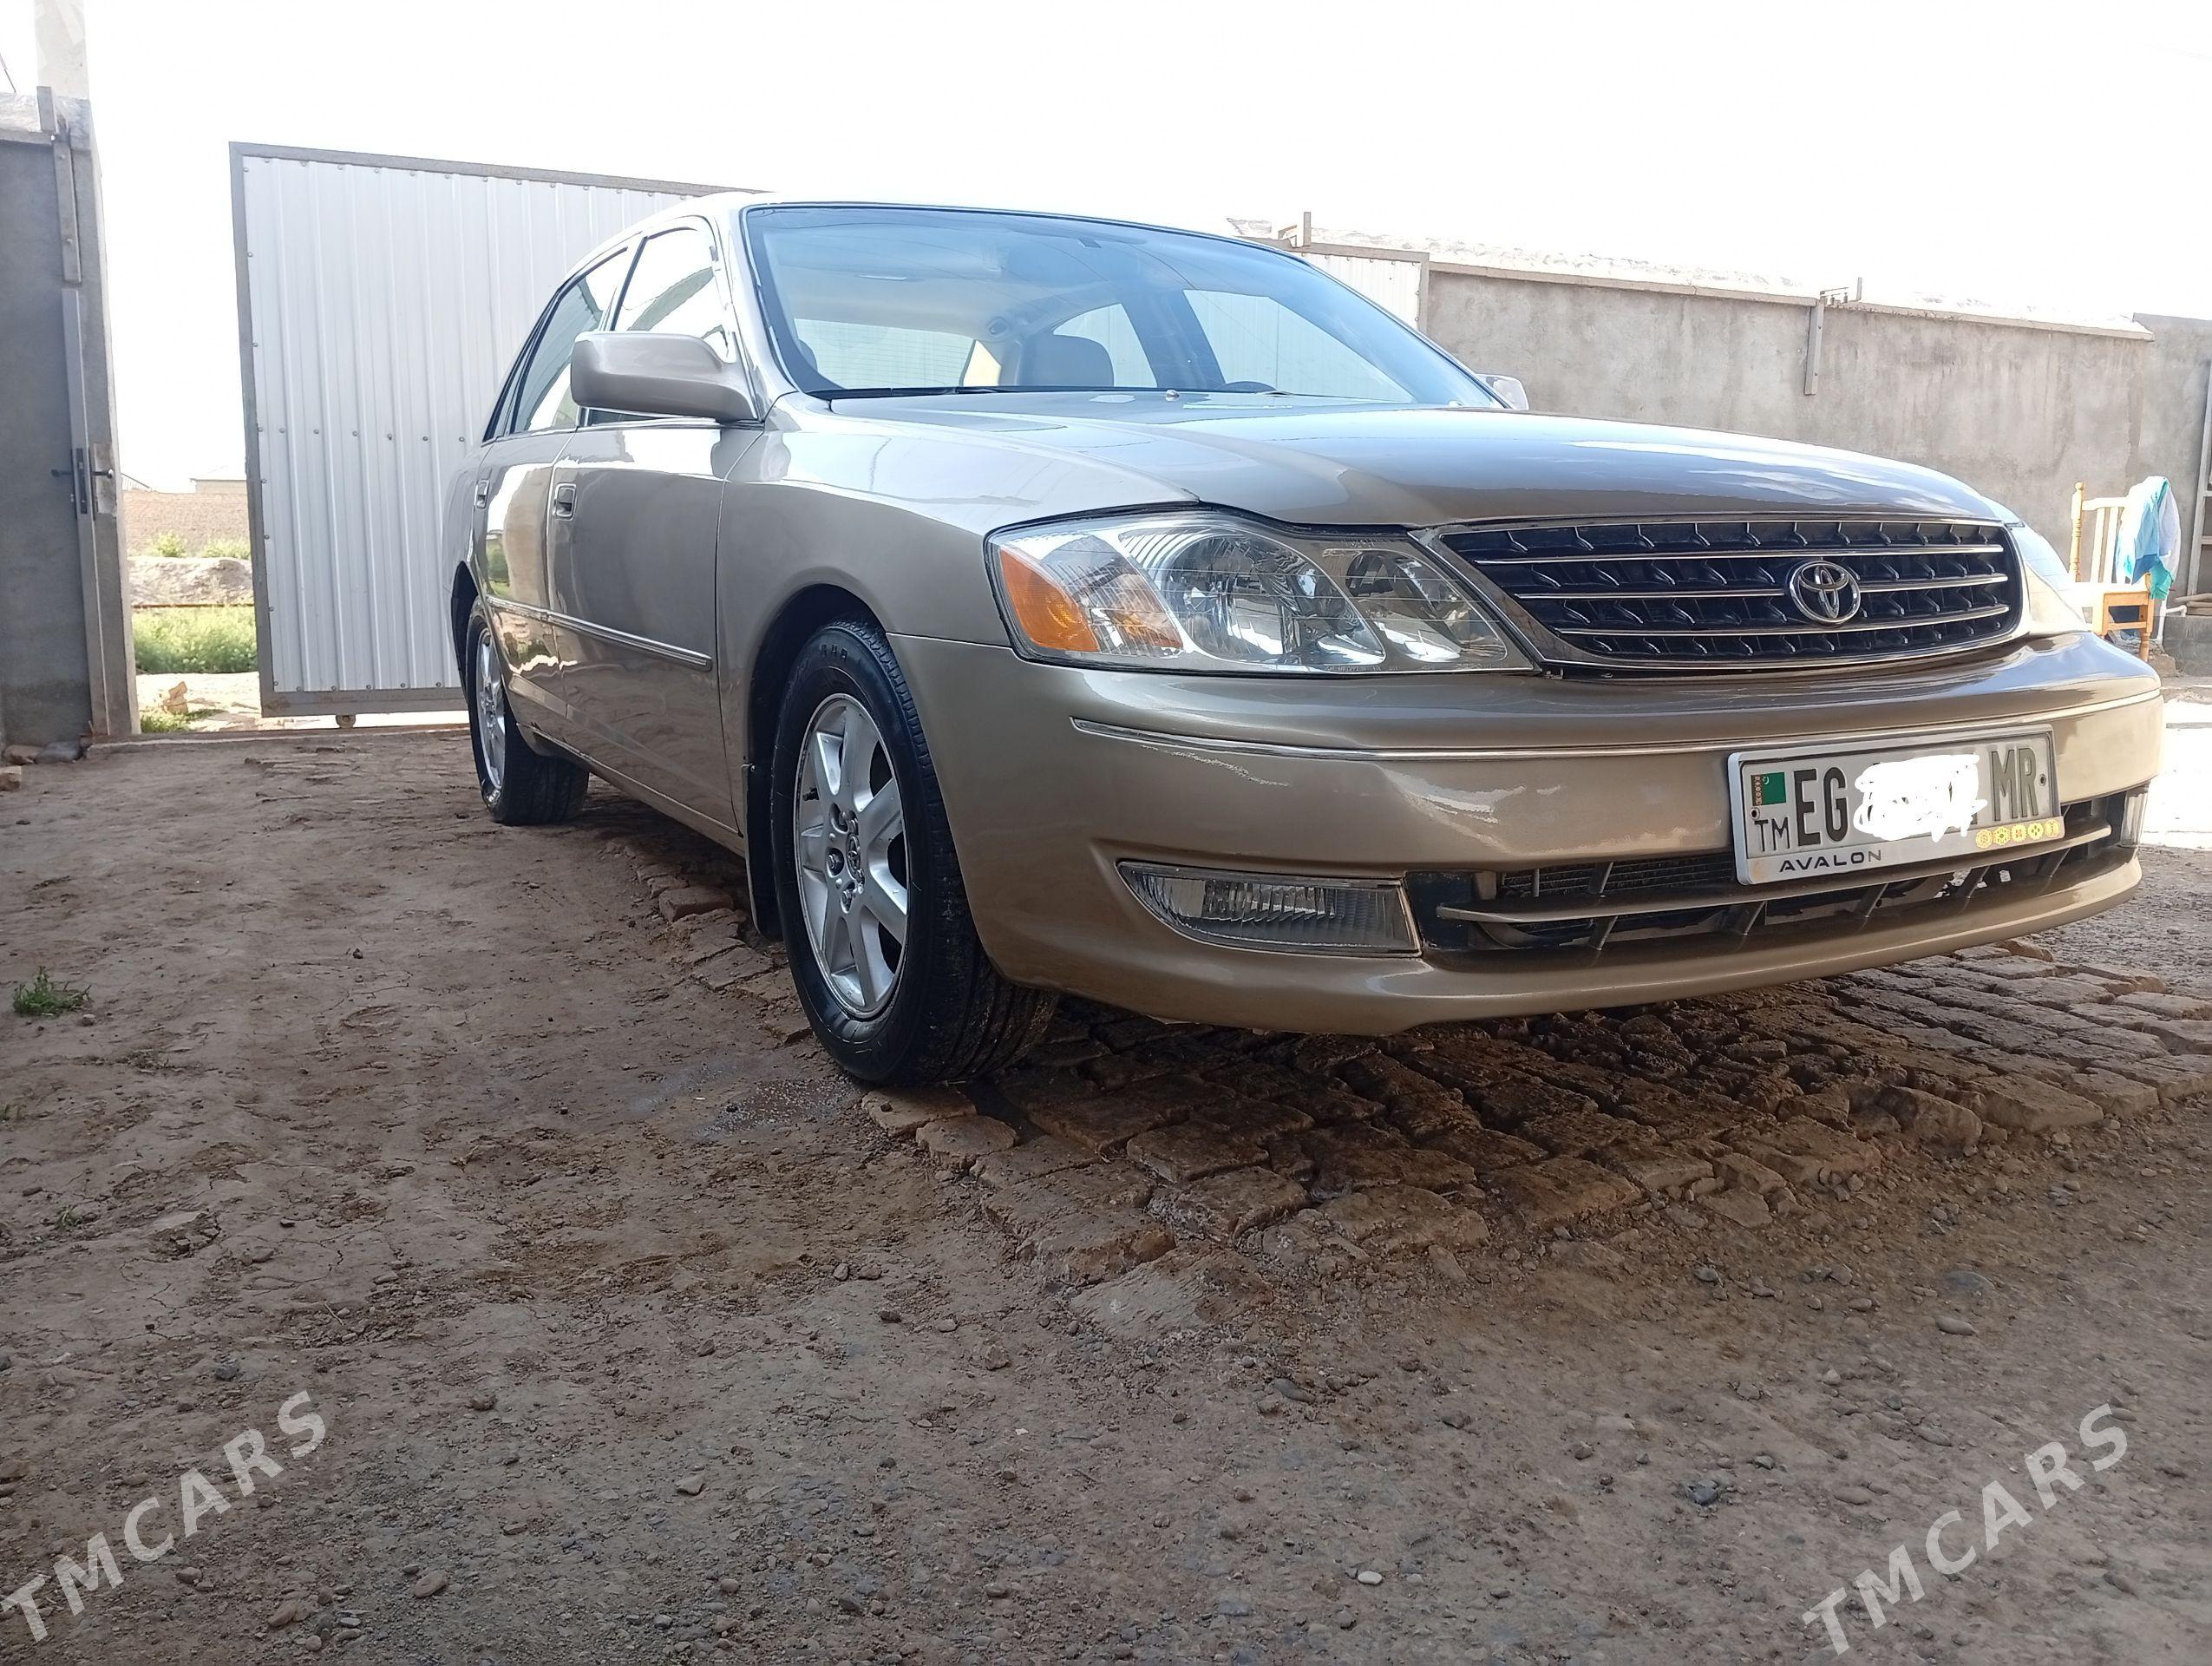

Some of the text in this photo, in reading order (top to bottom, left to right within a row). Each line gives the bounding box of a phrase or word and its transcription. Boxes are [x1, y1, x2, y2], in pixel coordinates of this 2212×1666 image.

[1793, 766, 1849, 847] EG
[1991, 747, 2039, 821] MR
[1754, 817, 1790, 852] TM
[1779, 849, 1882, 873] AVALON
